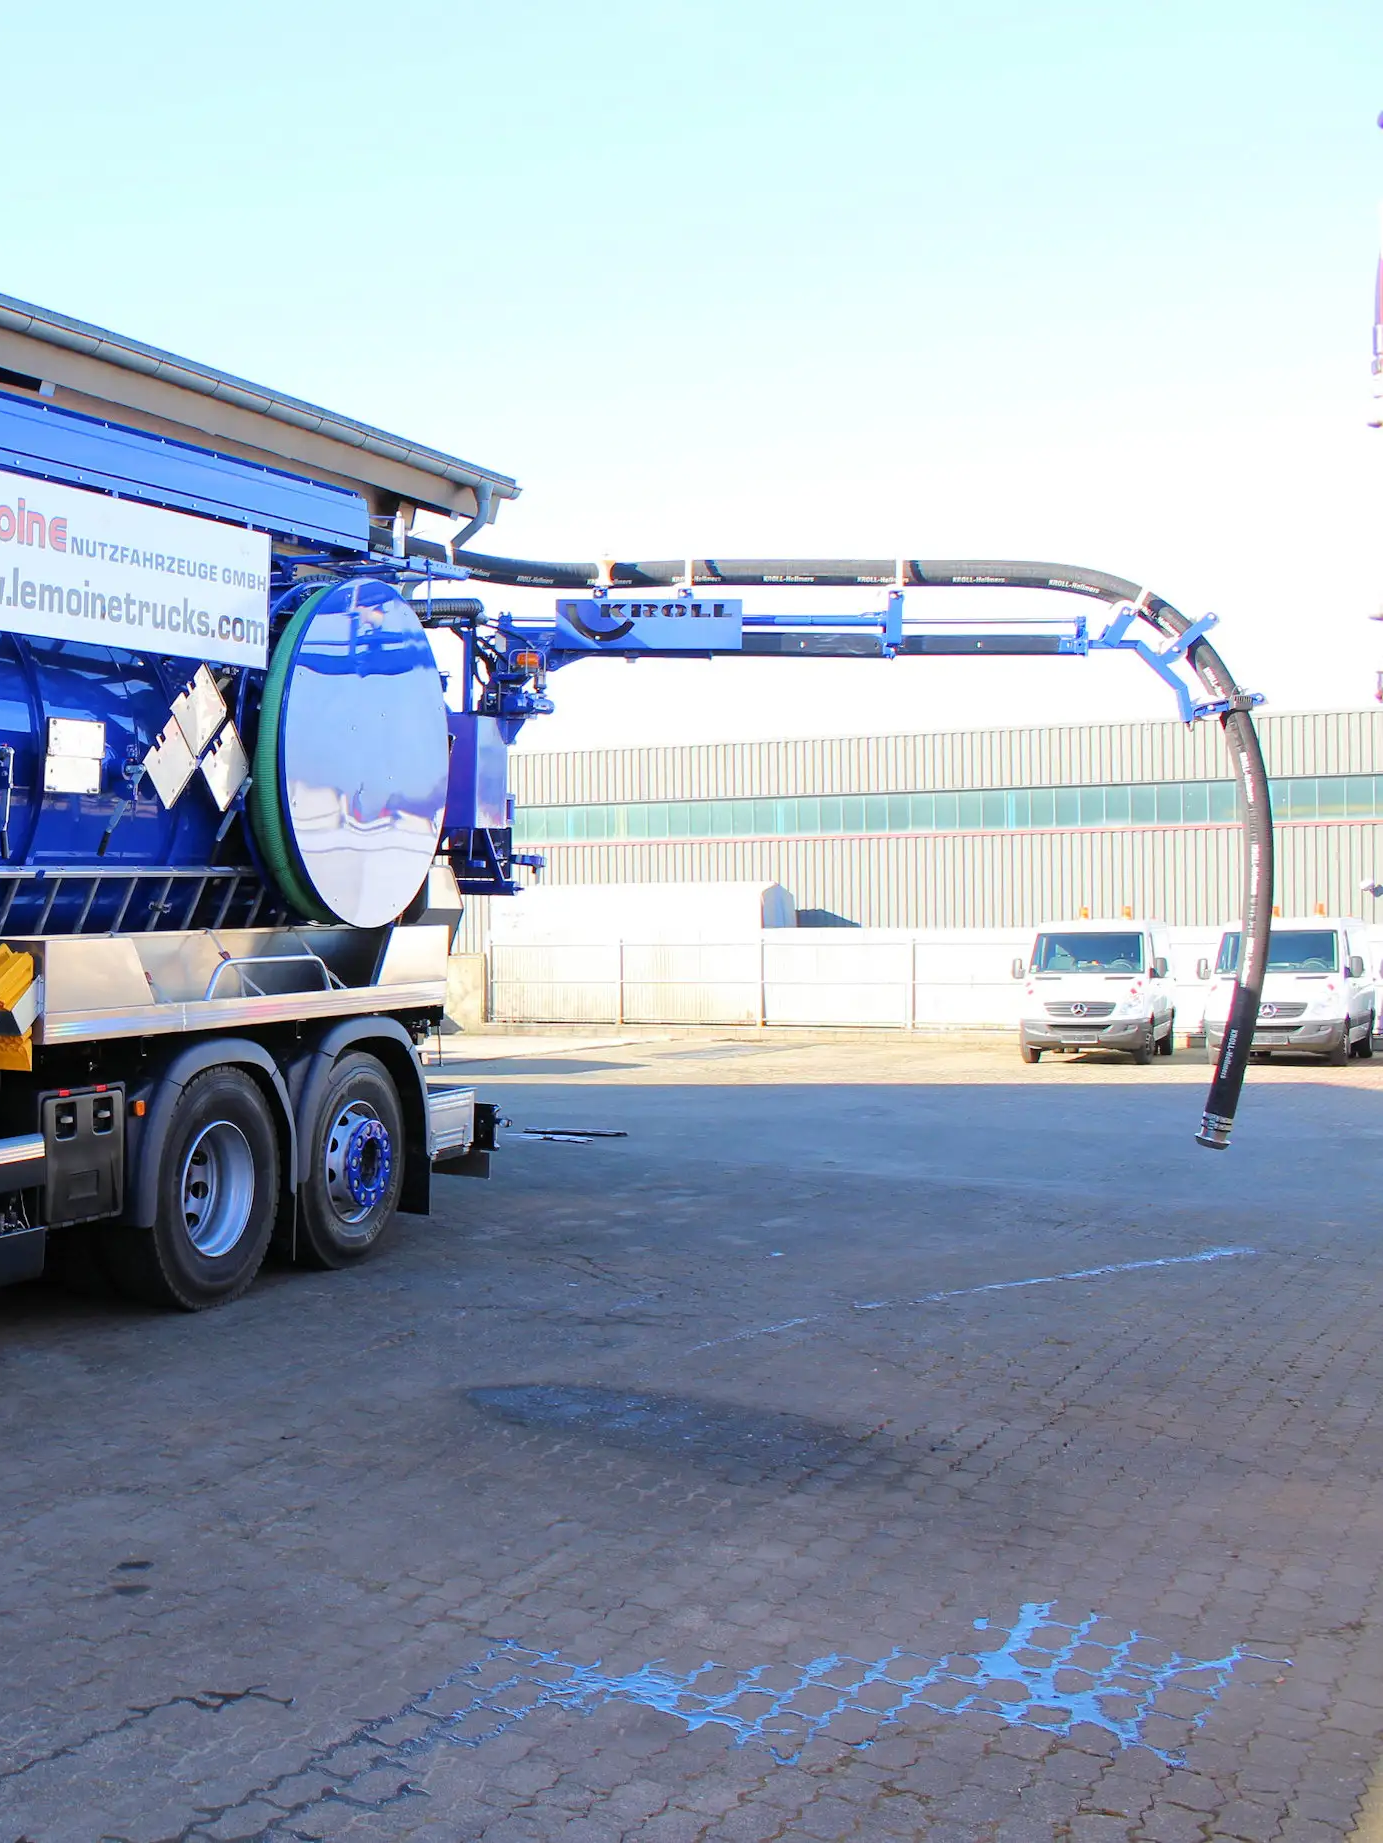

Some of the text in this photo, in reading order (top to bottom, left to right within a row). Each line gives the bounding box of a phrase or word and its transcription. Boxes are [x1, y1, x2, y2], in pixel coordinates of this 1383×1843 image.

[71, 536, 218, 582] NUTZFAHRZEUGE
[222, 567, 267, 592] GMBH
[600, 603, 733, 619] KROLL
